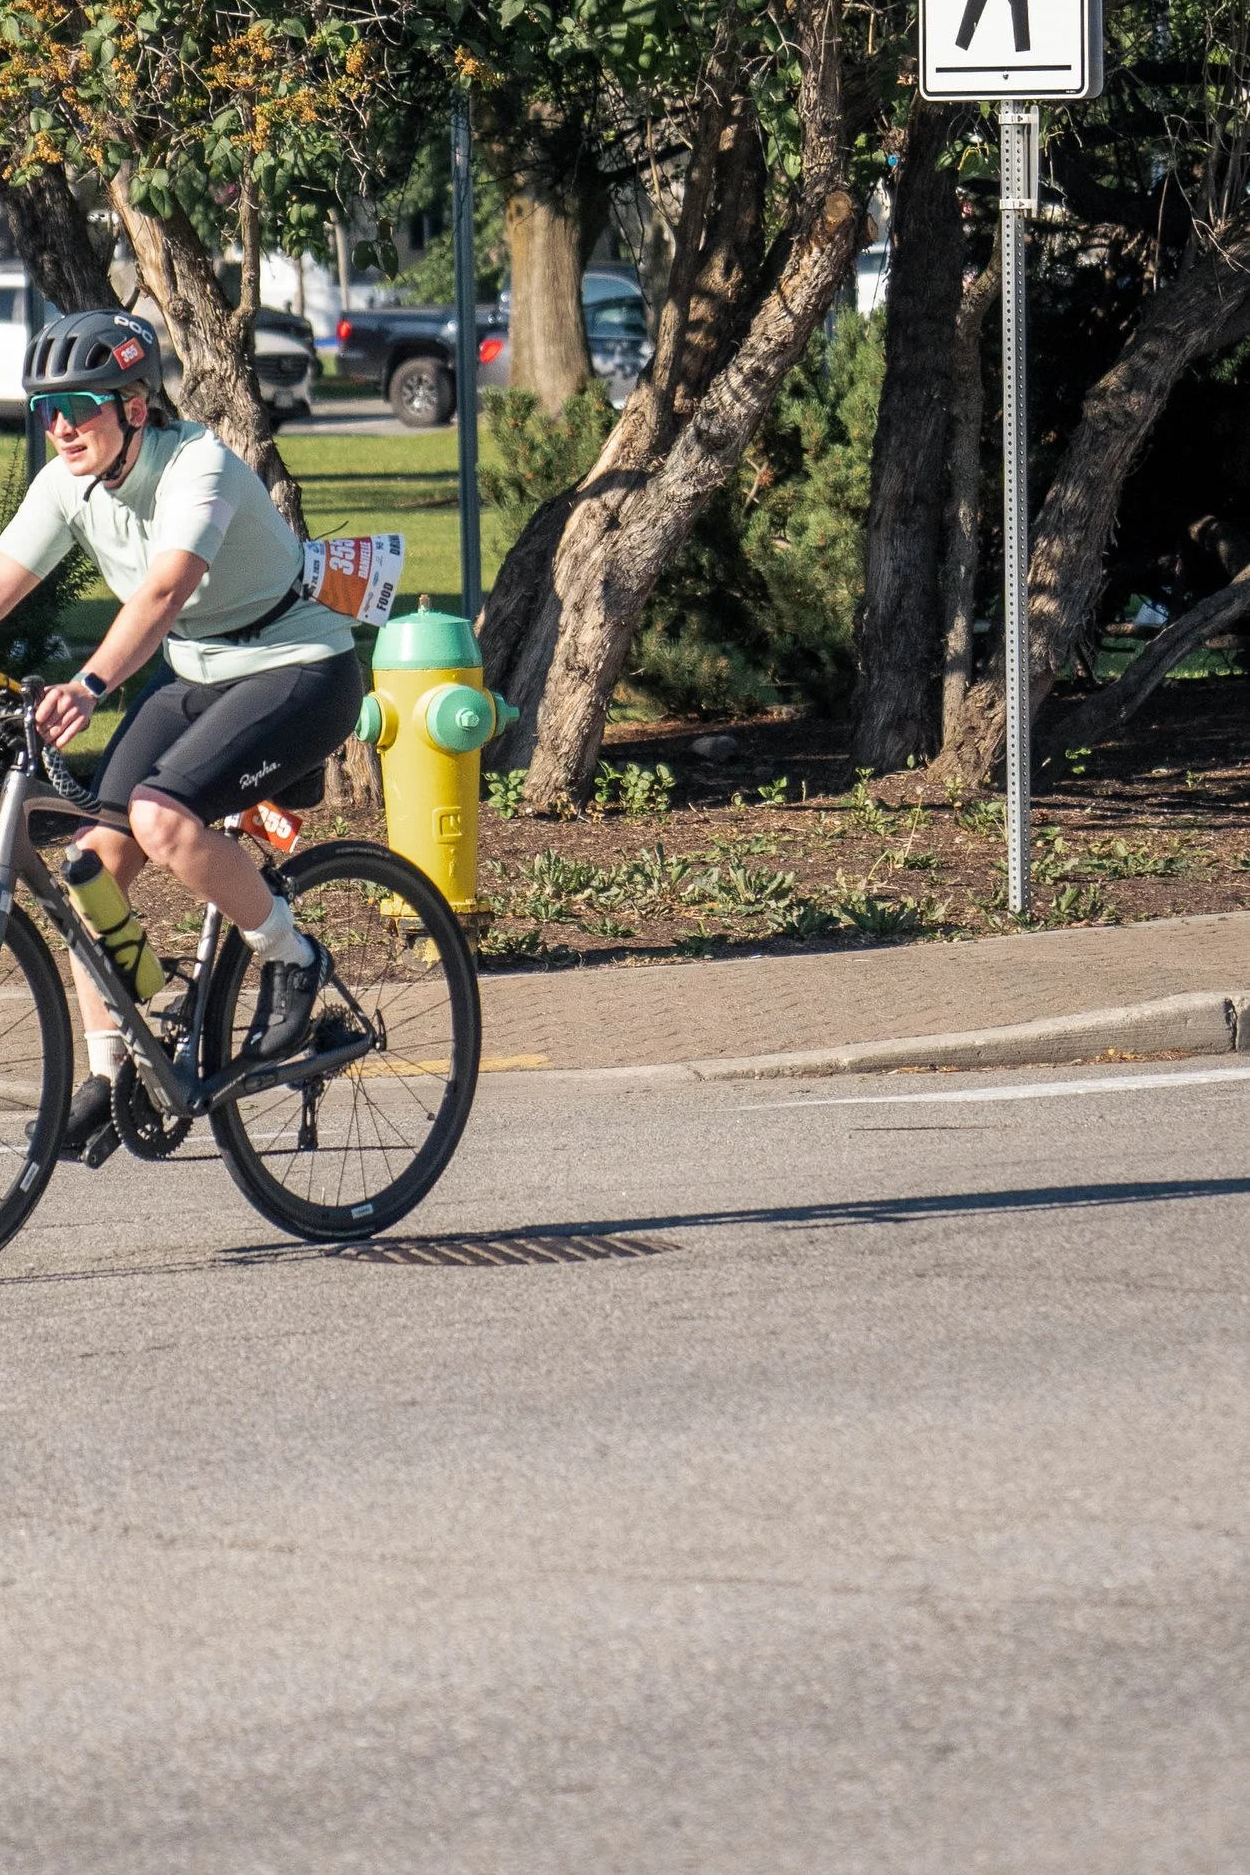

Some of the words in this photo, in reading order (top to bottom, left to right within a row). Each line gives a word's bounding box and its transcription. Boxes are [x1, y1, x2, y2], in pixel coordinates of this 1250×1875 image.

[113, 315, 153, 344] POC
[120, 344, 139, 363] 355
[329, 539, 356, 576] 355
[376, 582, 395, 612] FOOD
[252, 805, 292, 839] 355
